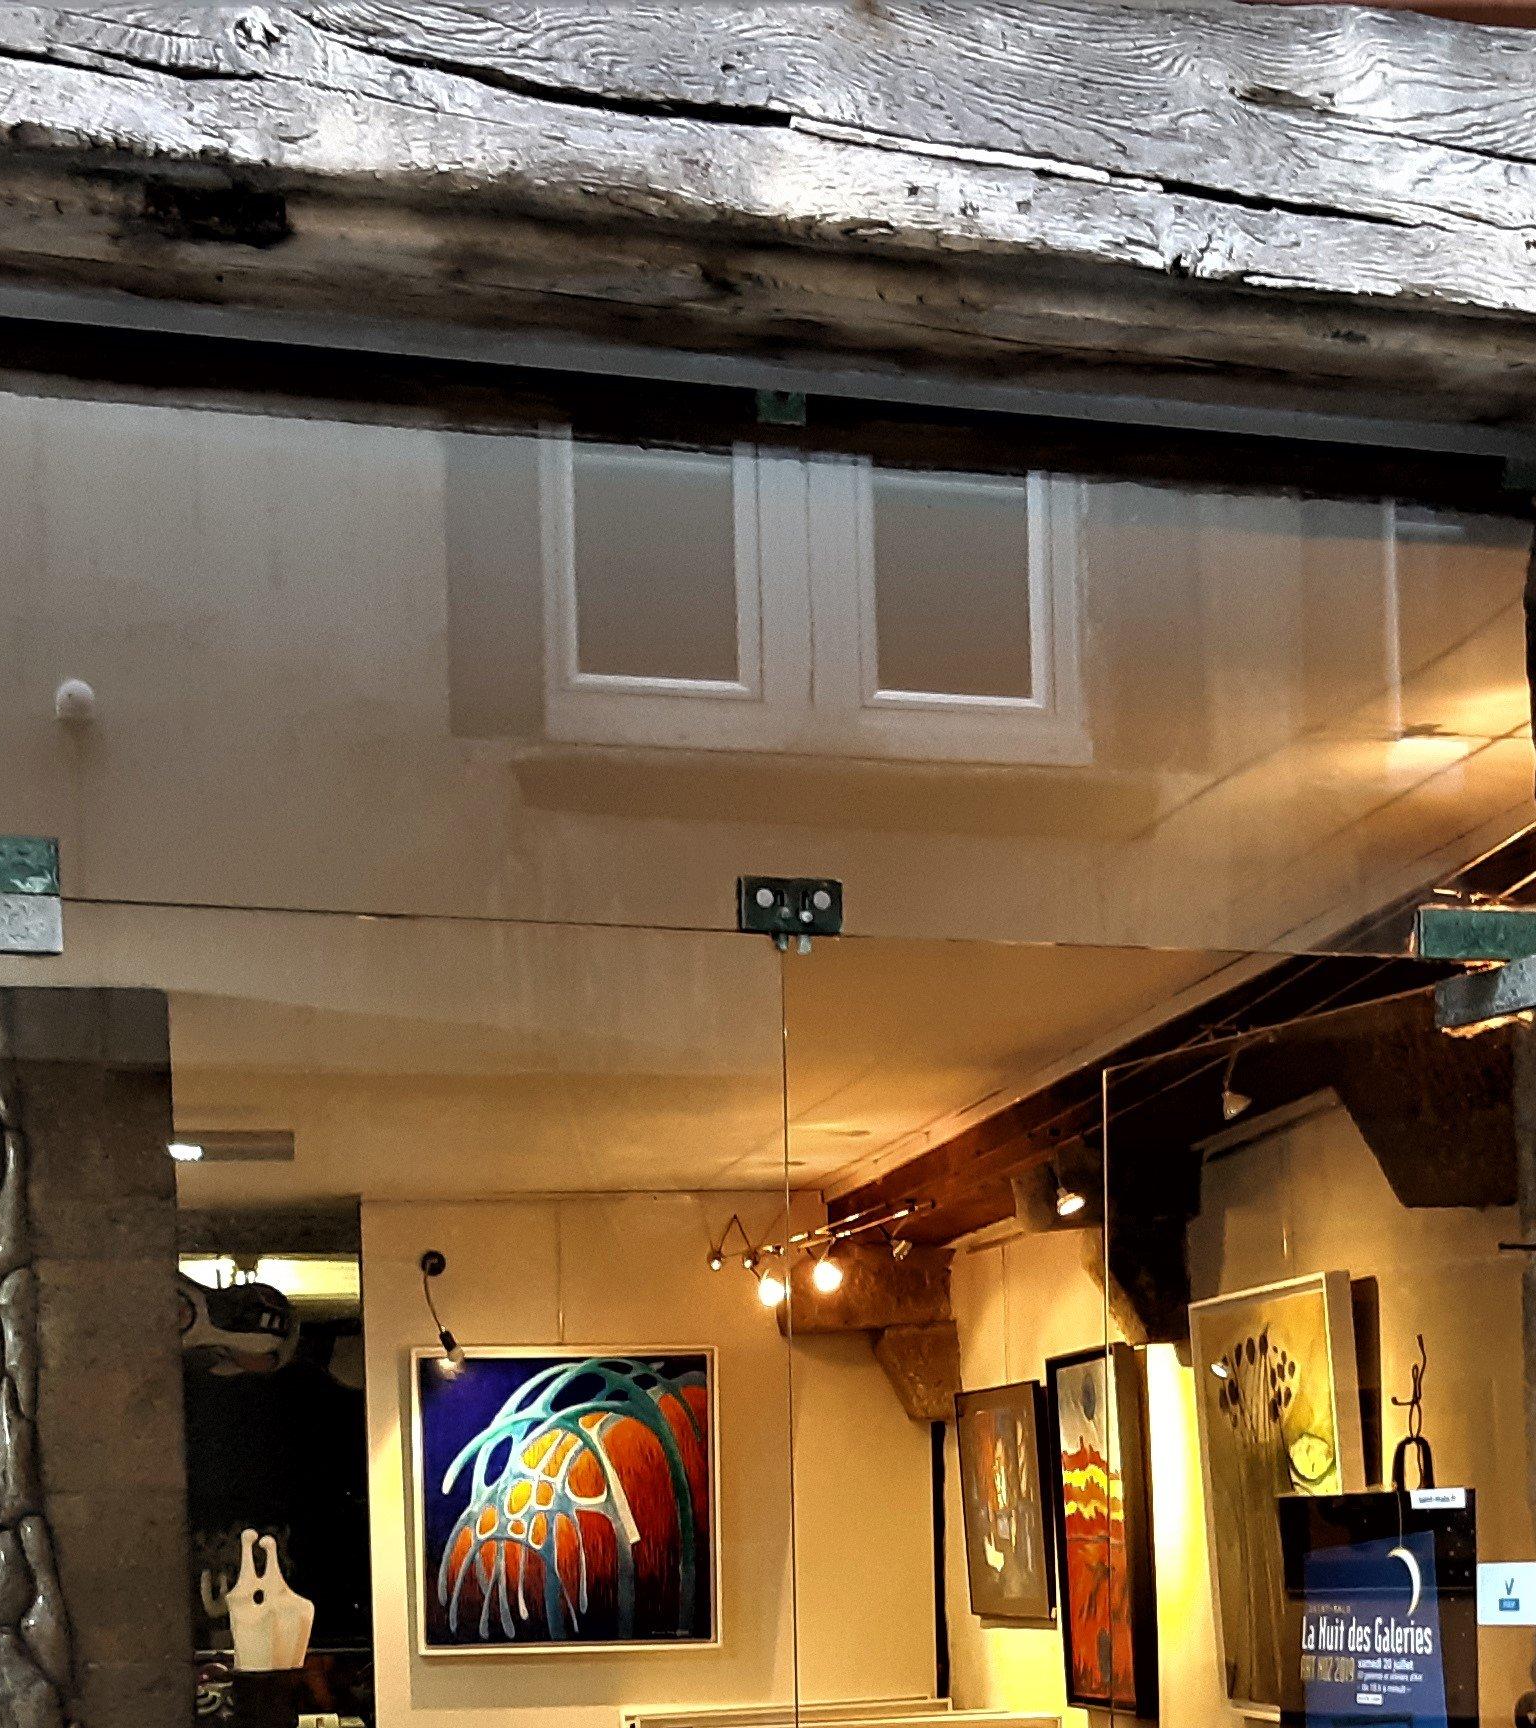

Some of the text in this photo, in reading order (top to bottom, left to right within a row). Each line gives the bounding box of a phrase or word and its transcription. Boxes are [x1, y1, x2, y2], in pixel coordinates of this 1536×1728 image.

[1302, 1615, 1433, 1655] La Nuit des Galeries
